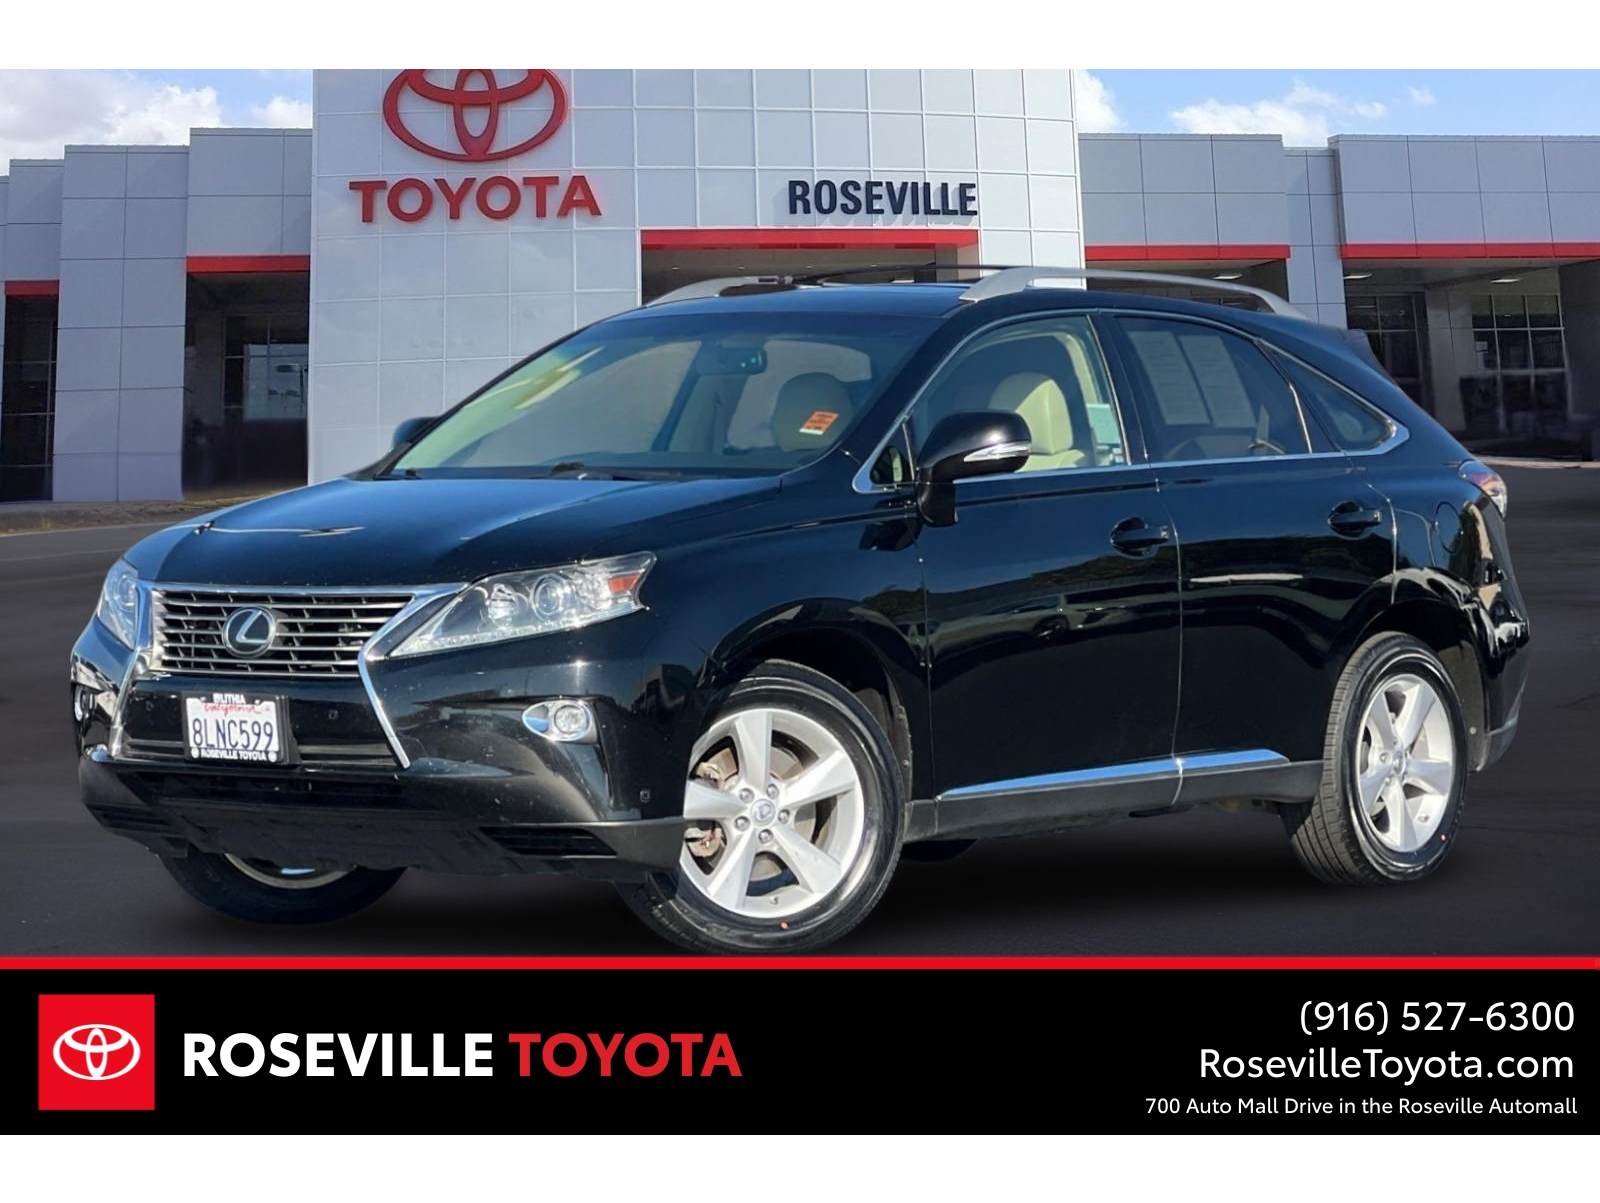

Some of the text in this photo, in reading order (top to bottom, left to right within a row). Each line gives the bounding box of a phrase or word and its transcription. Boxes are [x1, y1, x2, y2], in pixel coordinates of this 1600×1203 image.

[349, 175, 602, 223] TOYOTA
[788, 180, 979, 217] ROSEVILLE
[192, 718, 274, 752] 8LNC599
